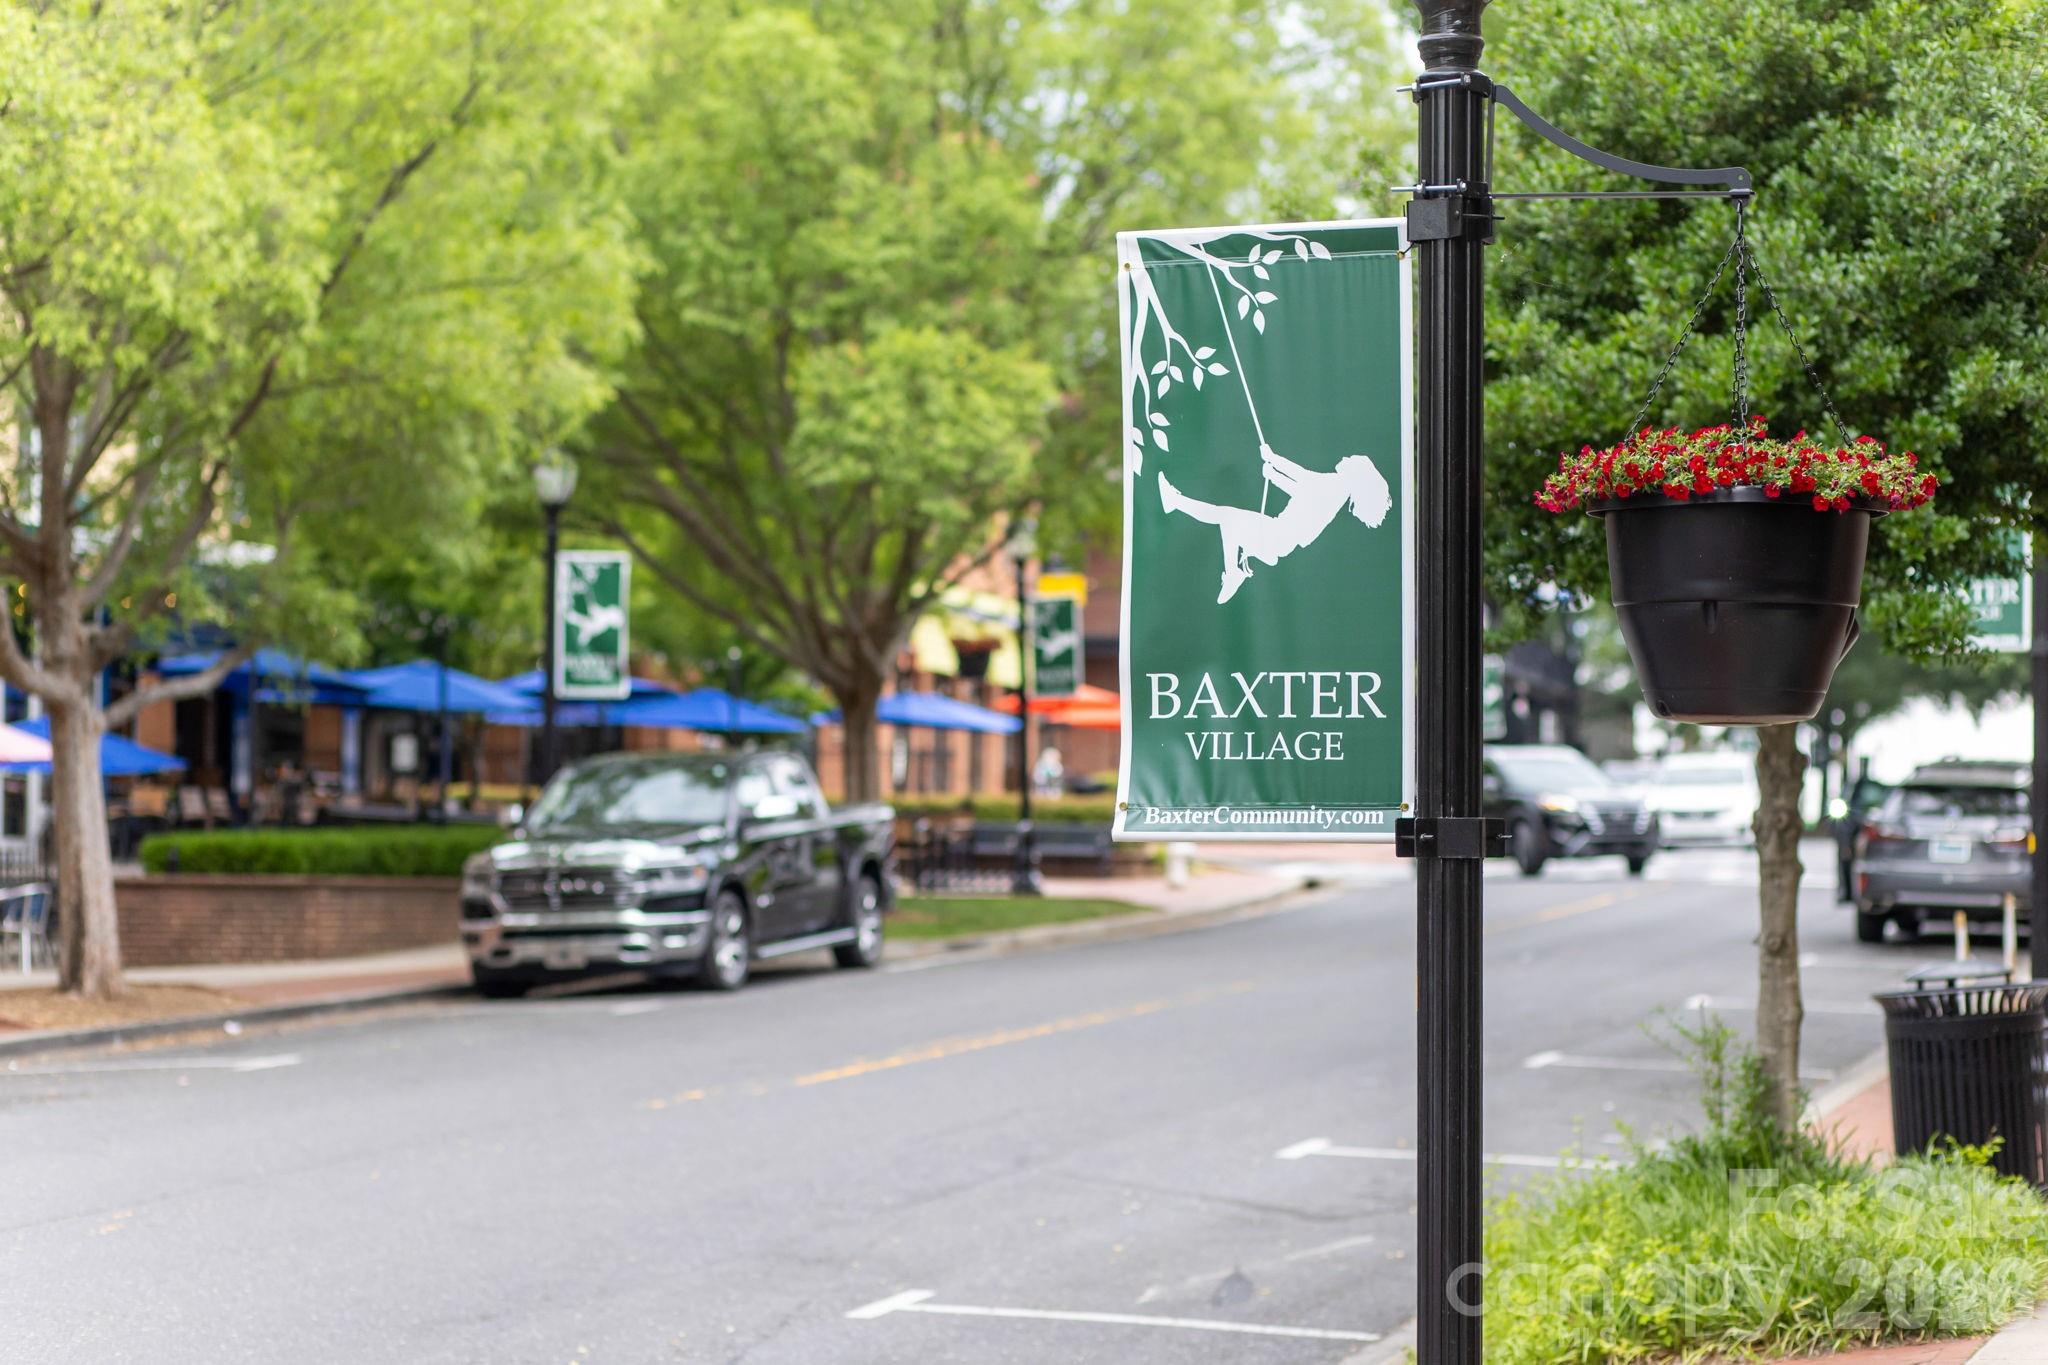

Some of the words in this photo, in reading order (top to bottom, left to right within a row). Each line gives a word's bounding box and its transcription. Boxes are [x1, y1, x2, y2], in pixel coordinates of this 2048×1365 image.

[1145, 671, 1387, 720] BAXTER
[1185, 731, 1344, 761] VILLAGE
[1144, 805, 1384, 829] BaxterCommunity.com
